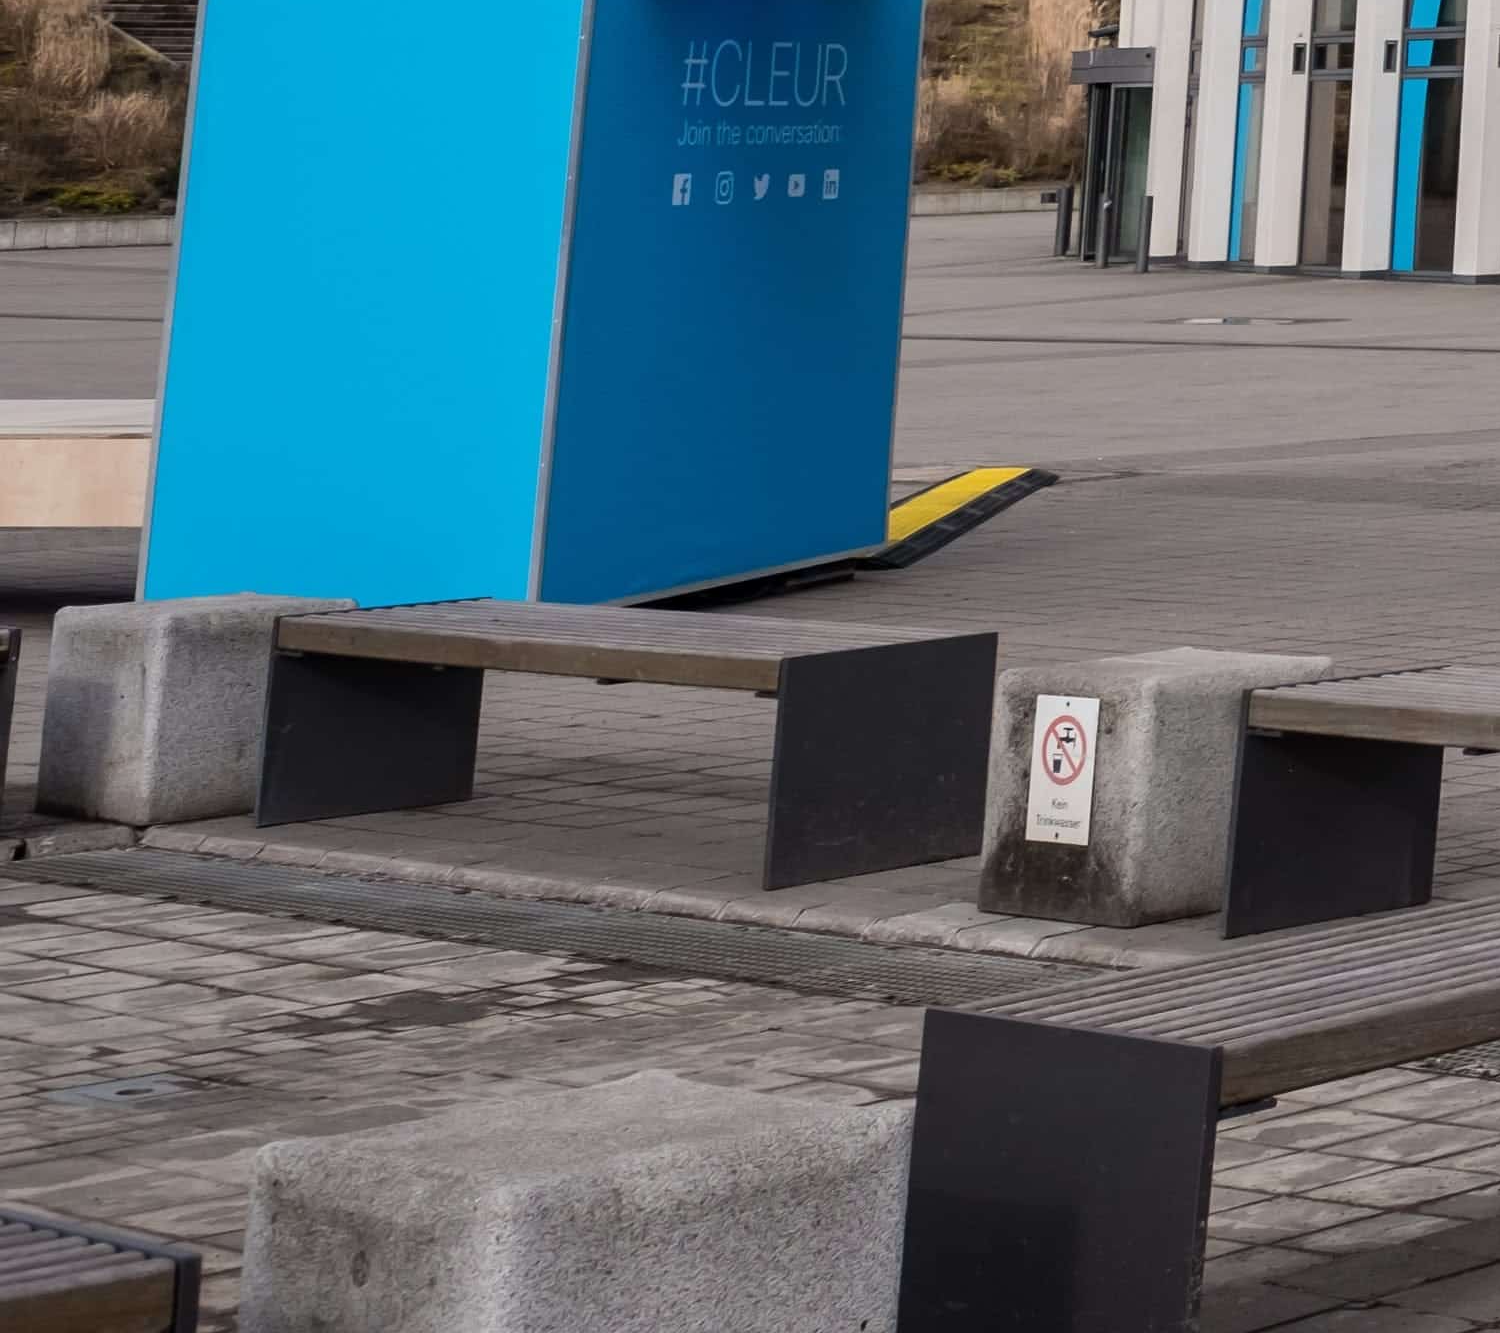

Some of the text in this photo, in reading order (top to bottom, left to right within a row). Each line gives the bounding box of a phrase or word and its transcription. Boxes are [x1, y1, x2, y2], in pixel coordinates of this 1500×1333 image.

[681, 39, 848, 107] #CLEUR
[677, 117, 712, 147] Join
[716, 117, 742, 146] the
